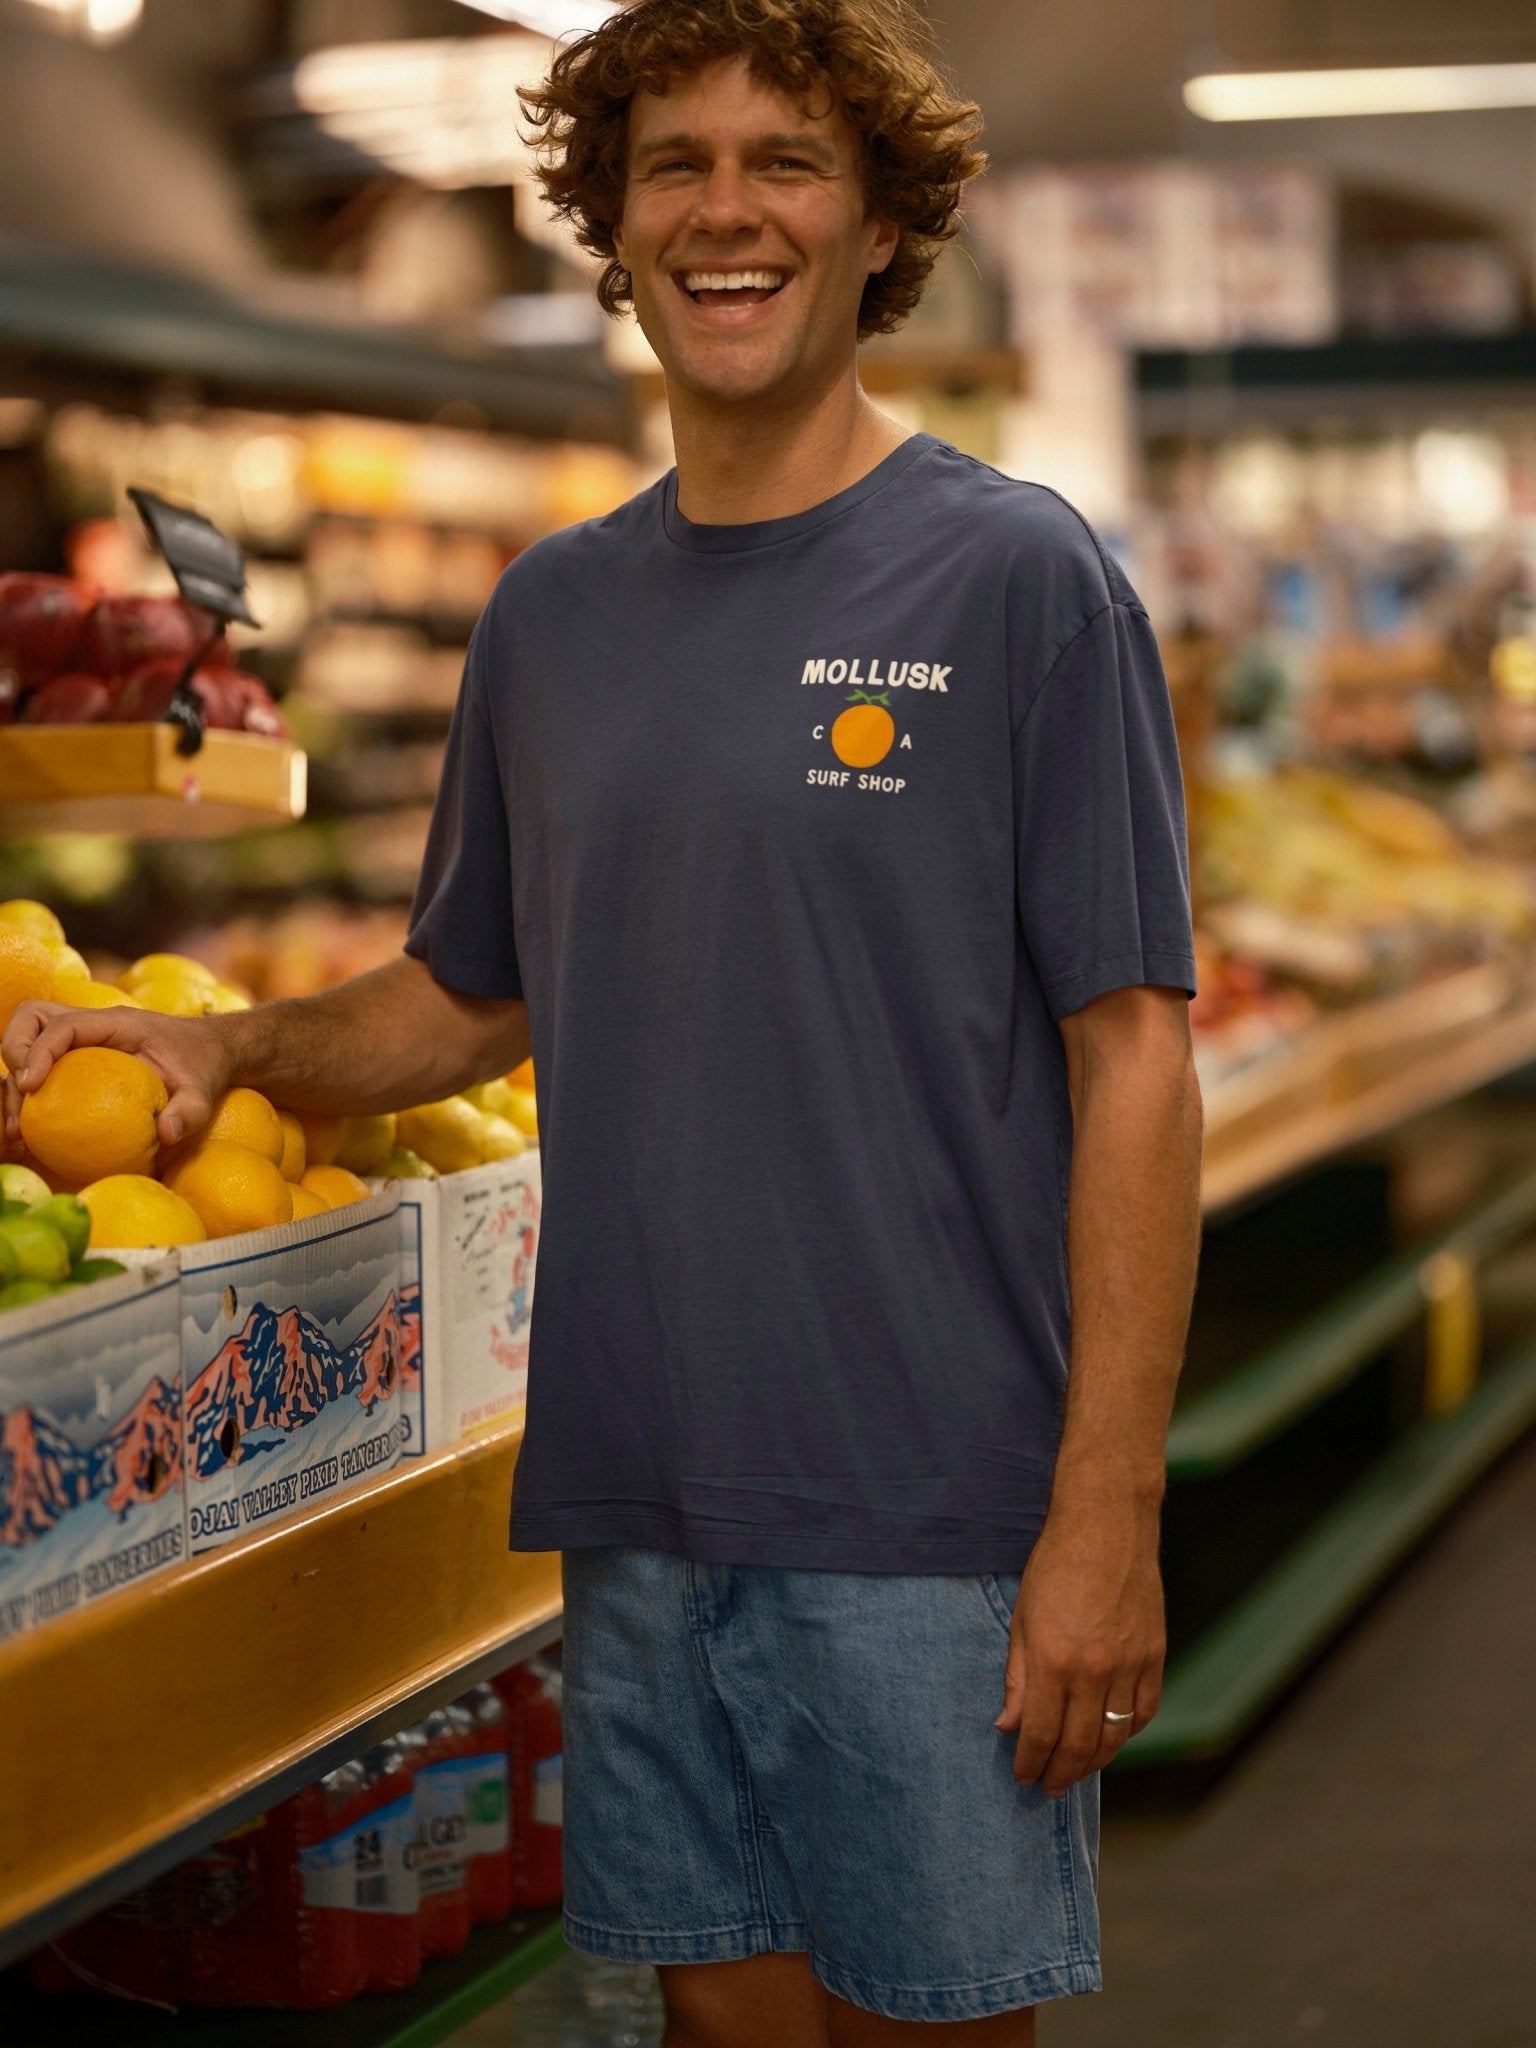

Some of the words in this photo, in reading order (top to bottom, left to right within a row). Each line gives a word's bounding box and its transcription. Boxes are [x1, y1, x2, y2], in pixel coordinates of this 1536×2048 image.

[801, 659, 953, 693] MOLLUSK
[812, 725, 825, 740] C
[900, 733, 912, 749] A
[806, 769, 850, 787] SURF
[857, 774, 906, 794] SHOP
[190, 1498, 240, 1540] OJAI
[242, 1473, 298, 1523] VALLEY
[300, 1455, 339, 1499] PIXIE
[341, 1414, 412, 1481] TANGERS
